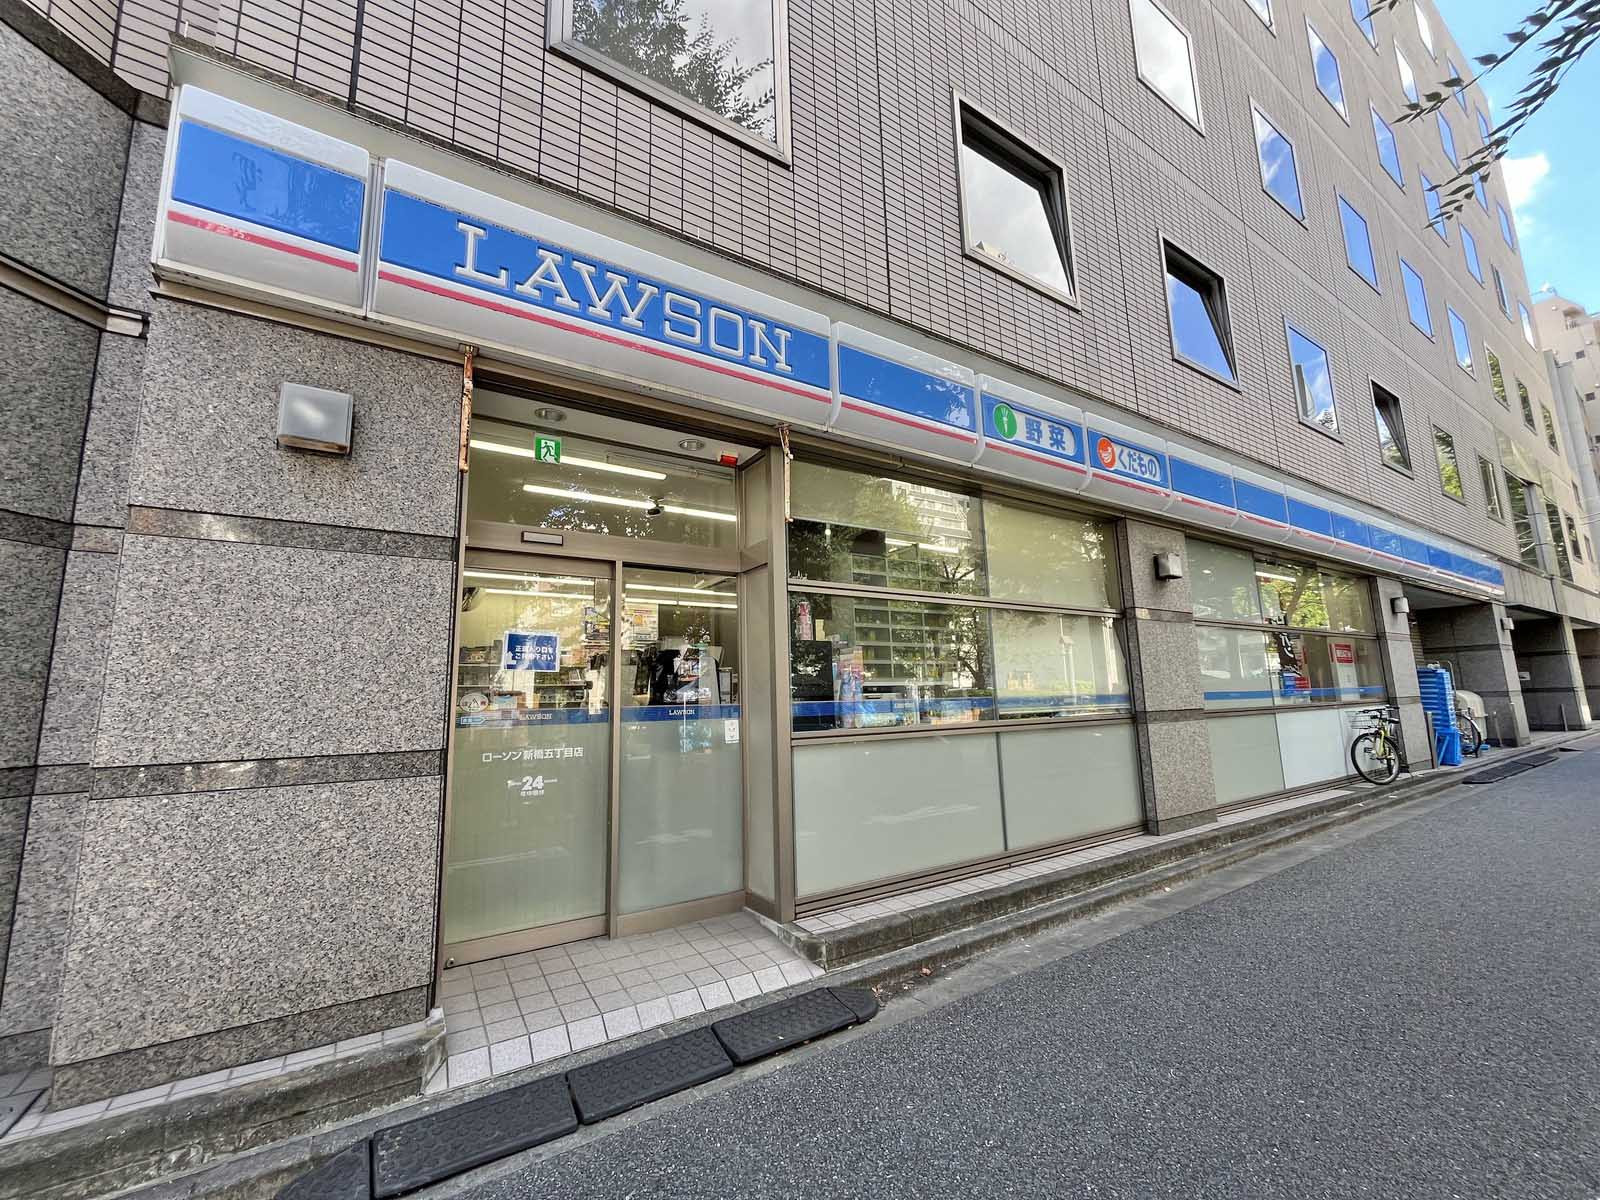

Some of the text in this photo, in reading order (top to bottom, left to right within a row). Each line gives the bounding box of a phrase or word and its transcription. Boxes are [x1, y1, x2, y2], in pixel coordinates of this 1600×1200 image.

[454, 221, 793, 372] LAWSON
[1025, 417, 1066, 451] 野菜
[1118, 447, 1158, 478] くだもの
[520, 713, 553, 721] LAWSON
[482, 747, 584, 762] ローソン新橋五丁目店
[521, 775, 544, 791] 24
